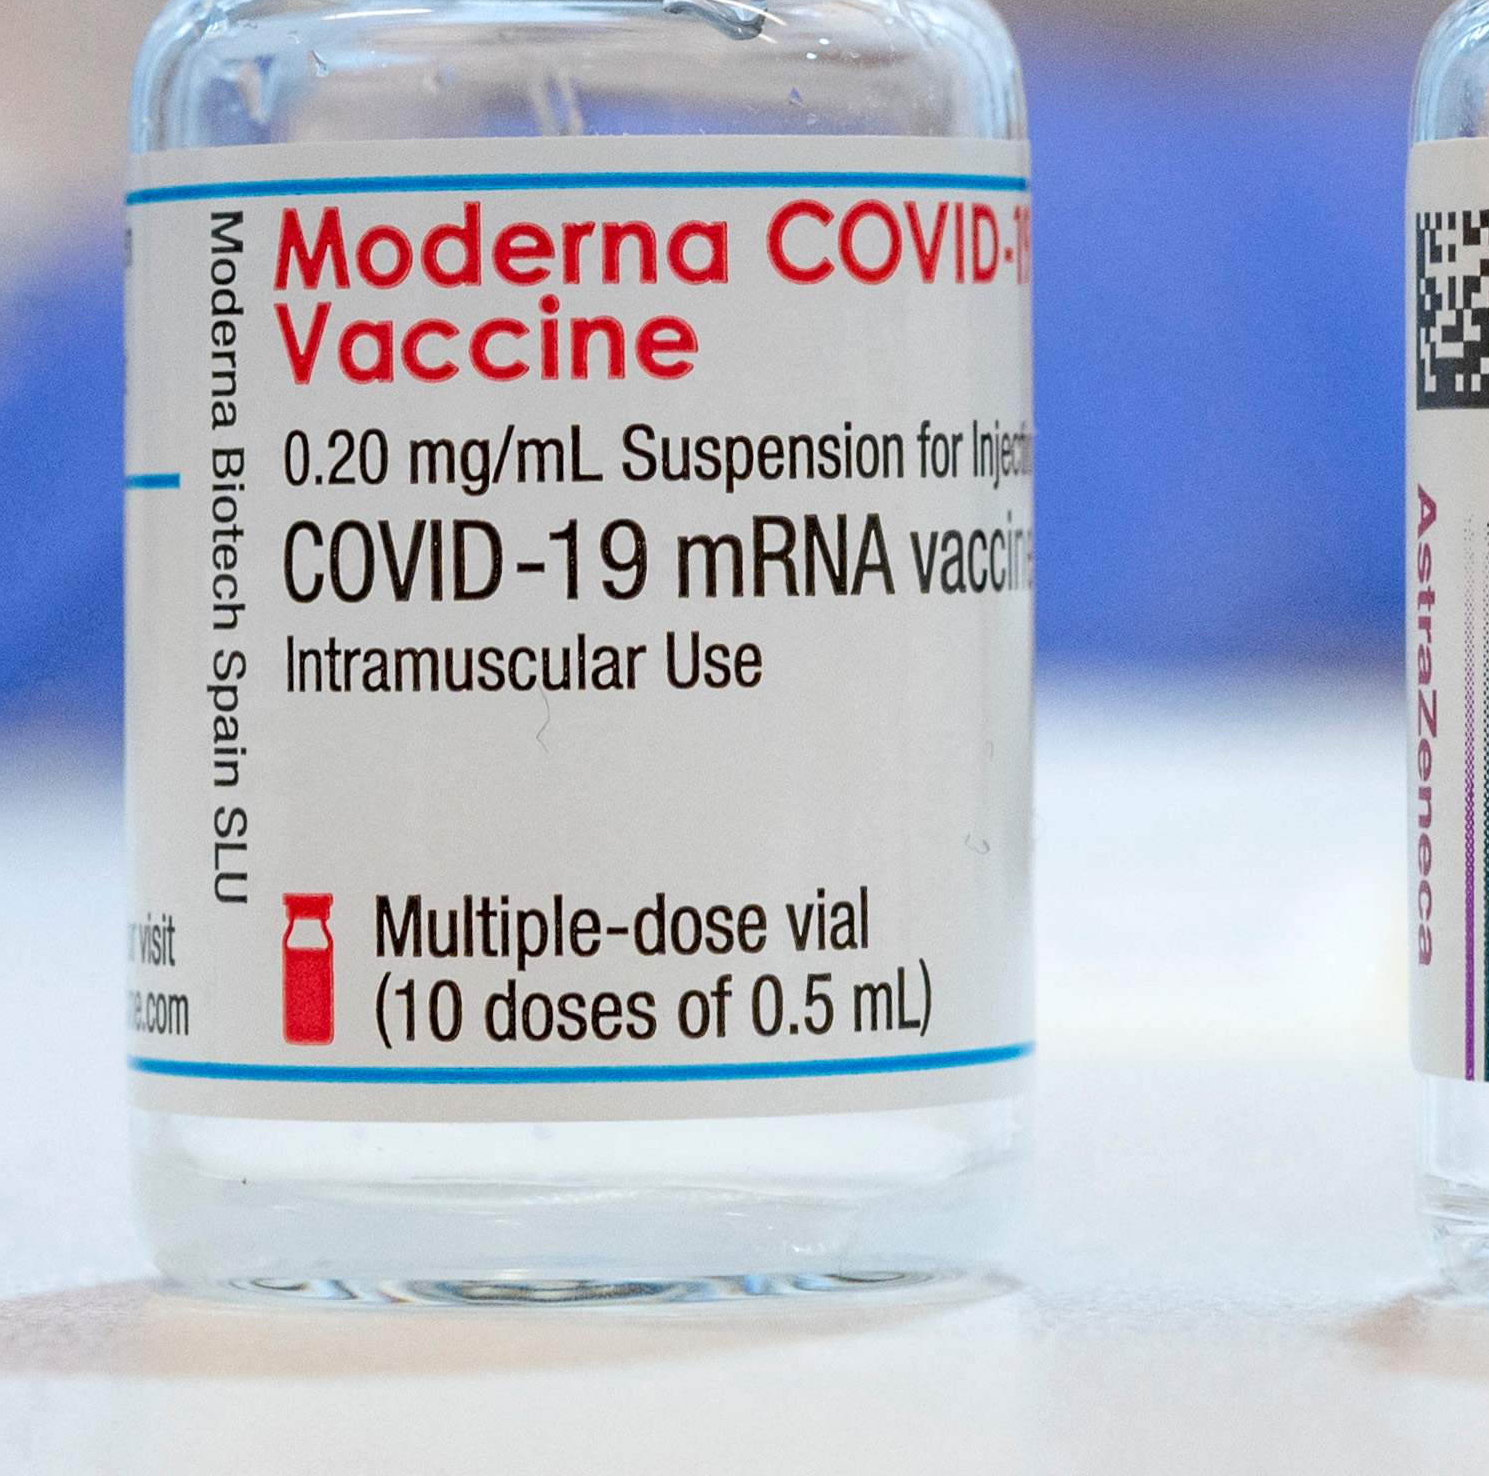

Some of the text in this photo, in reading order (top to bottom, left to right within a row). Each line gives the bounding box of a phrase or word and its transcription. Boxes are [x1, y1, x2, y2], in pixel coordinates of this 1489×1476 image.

[273, 200, 729, 291] Moderna
[273, 293, 699, 385] Vaccine
[283, 427, 389, 487] 0.20
[409, 423, 604, 497] mg/mL
[621, 420, 905, 494] Suspension
[916, 419, 964, 479] for
[206, 210, 248, 904] Moderna Biotech Spain SLU
[283, 518, 648, 604] COVID-19
[676, 512, 896, 599] mRNA
[286, 630, 763, 693] Intramuscular Use
[1417, 482, 1438, 967] AstraZeneca
[139, 912, 175, 966] visit
[375, 885, 869, 972] Multiple-dose vial
[375, 957, 932, 1050] (10 doses of 0.5 mL)
